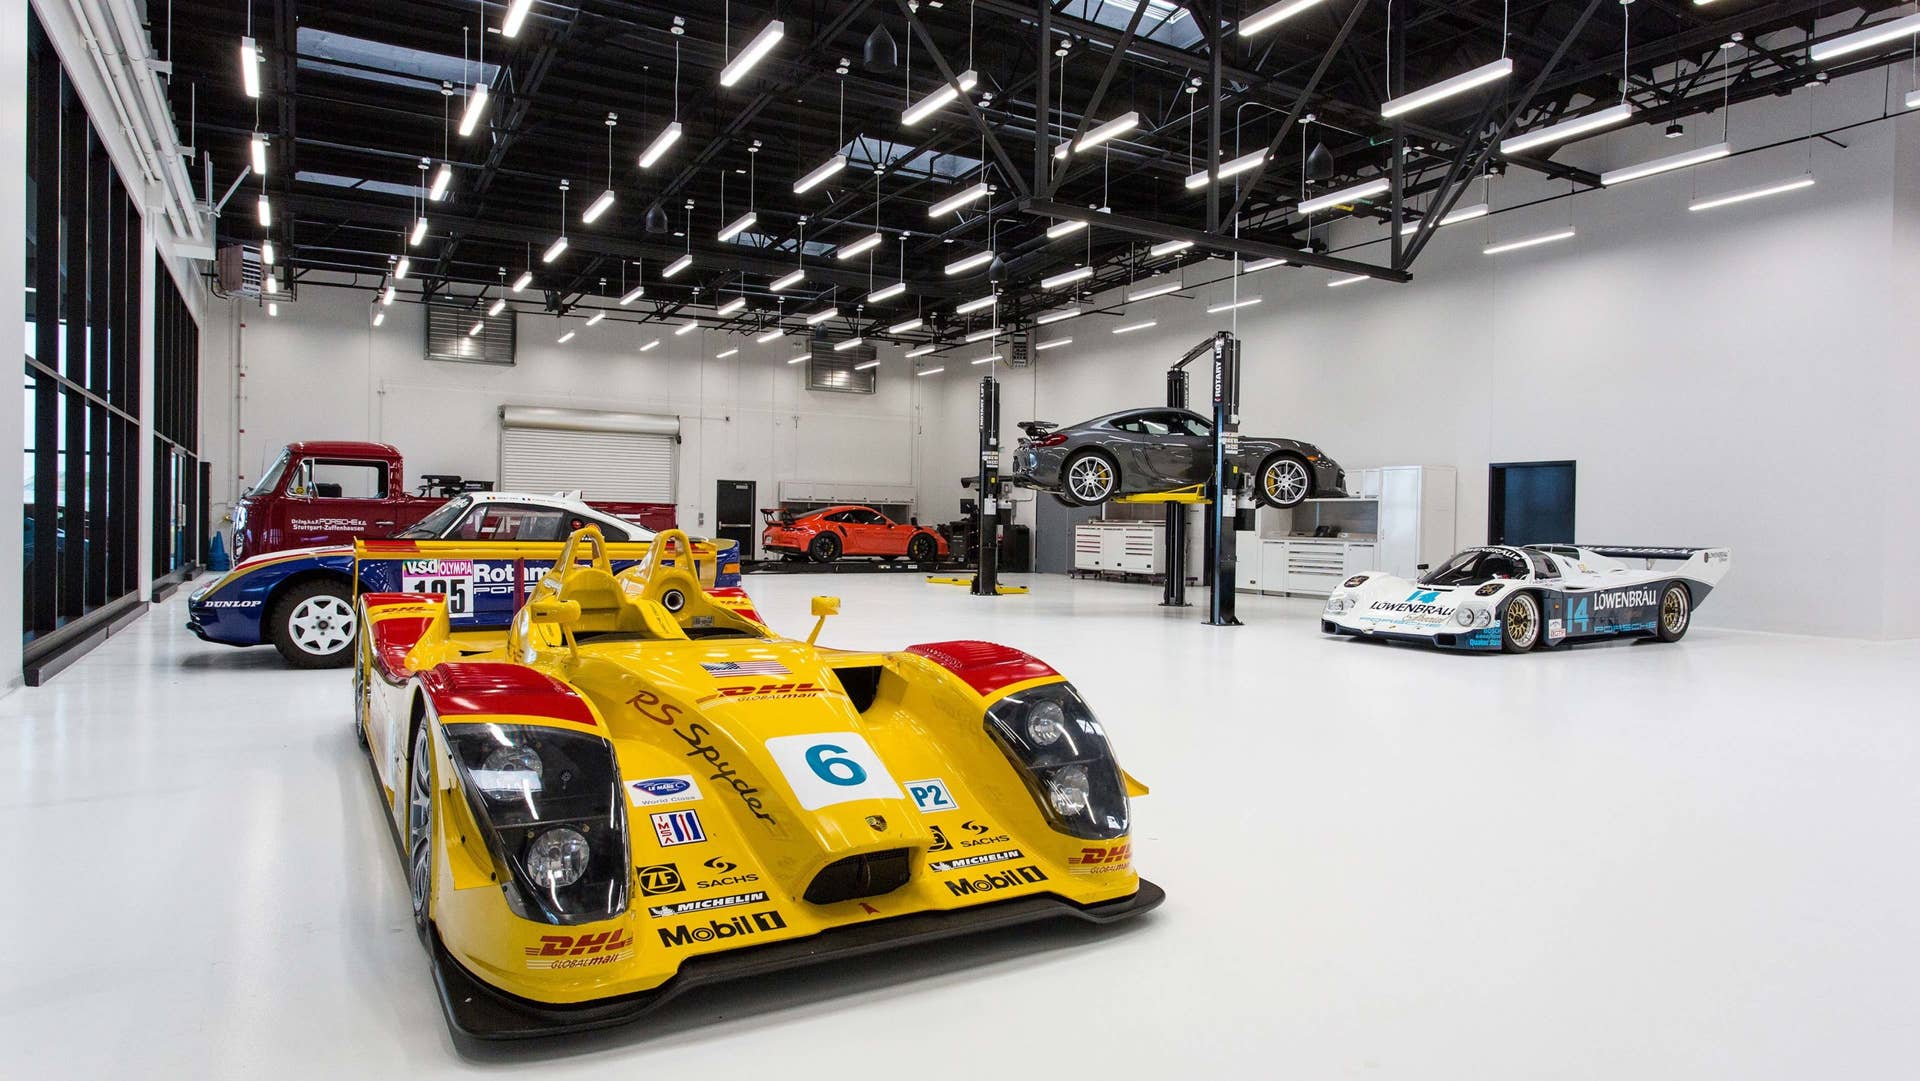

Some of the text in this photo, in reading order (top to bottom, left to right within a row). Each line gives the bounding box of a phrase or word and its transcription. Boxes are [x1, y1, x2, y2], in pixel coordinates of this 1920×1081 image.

[1214, 361, 1222, 397] ROTARY
[406, 560, 438, 574] vsd
[439, 561, 473, 576] OLYMPIA
[204, 600, 262, 608] DUNLOP
[1594, 587, 1657, 610] LÖWENBRÄU
[1567, 597, 1589, 633] 14
[1594, 621, 1657, 633] PORSCHE
[717, 683, 825, 698] DHL
[626, 690, 776, 825] RS Spyder
[805, 744, 868, 786] 6
[910, 785, 948, 807] P2
[657, 815, 675, 844] IMSA
[960, 834, 1010, 848] SACHS
[951, 850, 1019, 868] MICHELIN
[641, 869, 677, 890] ZF
[697, 873, 759, 889] SACHS
[944, 866, 1044, 897] Mobil 1
[677, 892, 764, 912] MICHELIN
[657, 912, 783, 948] Mobil 1
[540, 928, 625, 956] DHL
